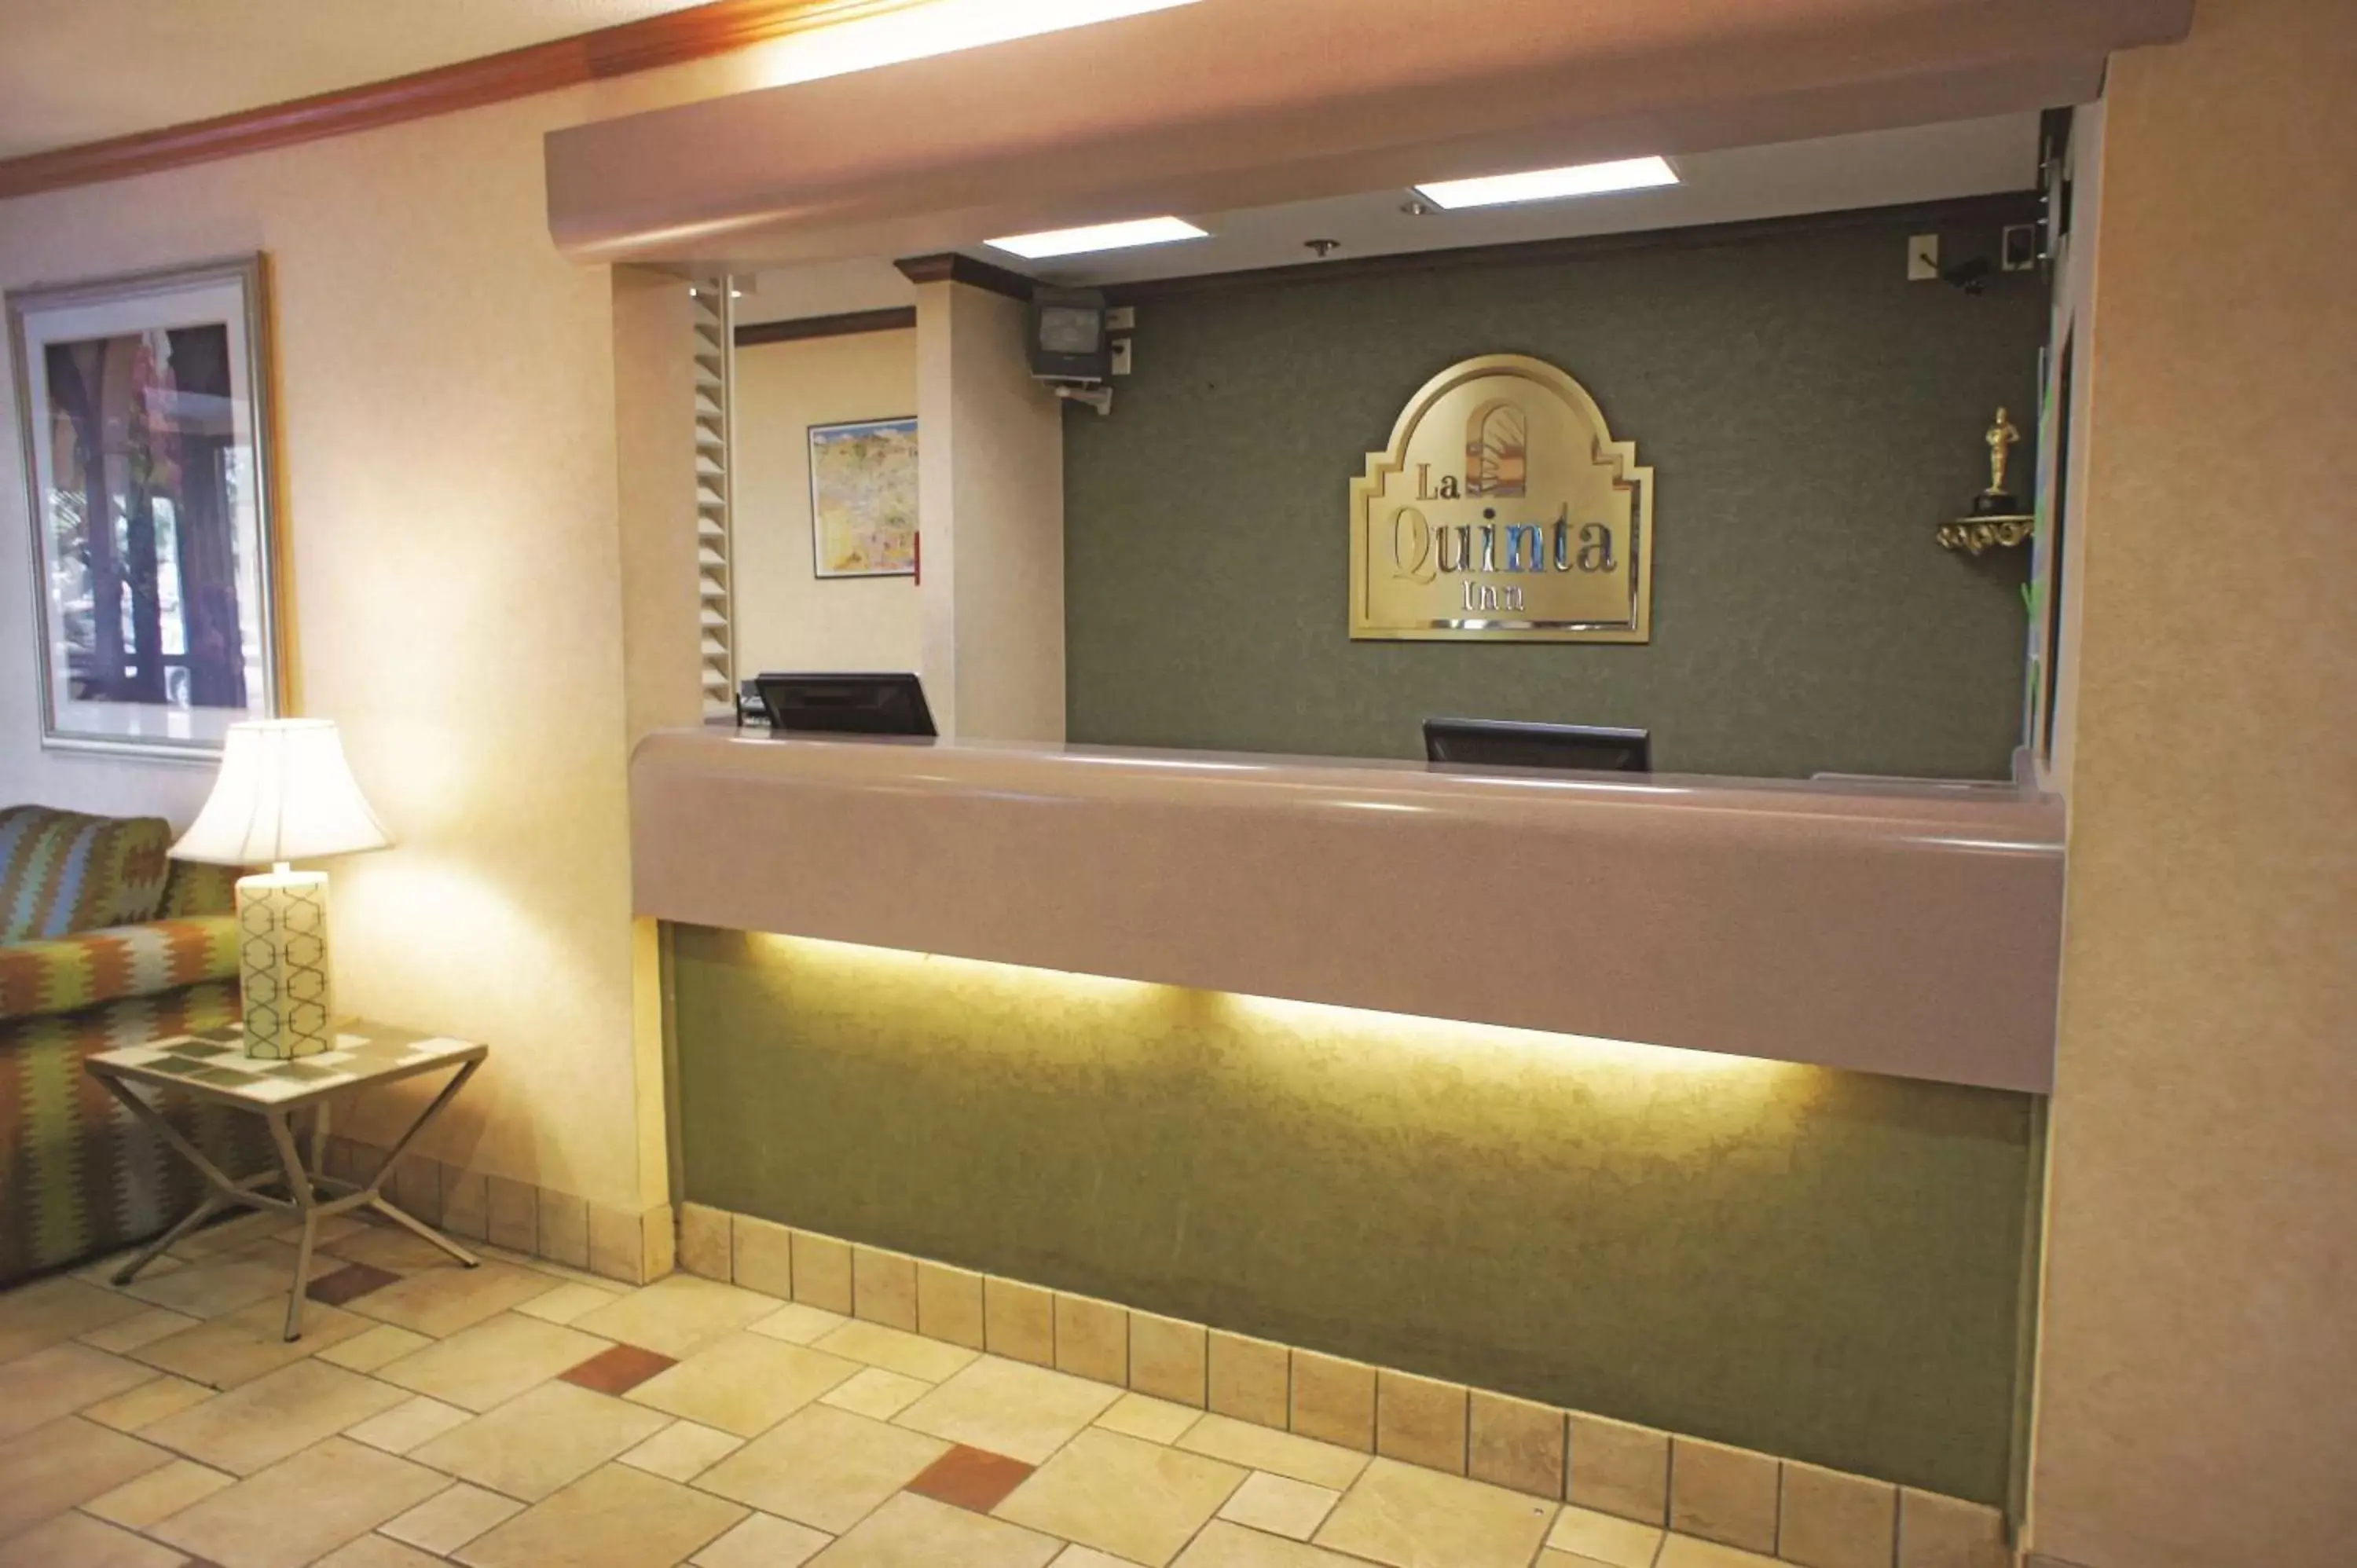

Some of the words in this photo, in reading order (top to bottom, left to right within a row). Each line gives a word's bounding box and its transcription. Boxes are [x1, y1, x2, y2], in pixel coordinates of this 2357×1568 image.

[1416, 463, 1461, 500] La
[1389, 503, 1617, 584] Quinta
[1461, 581, 1524, 610] Inn
